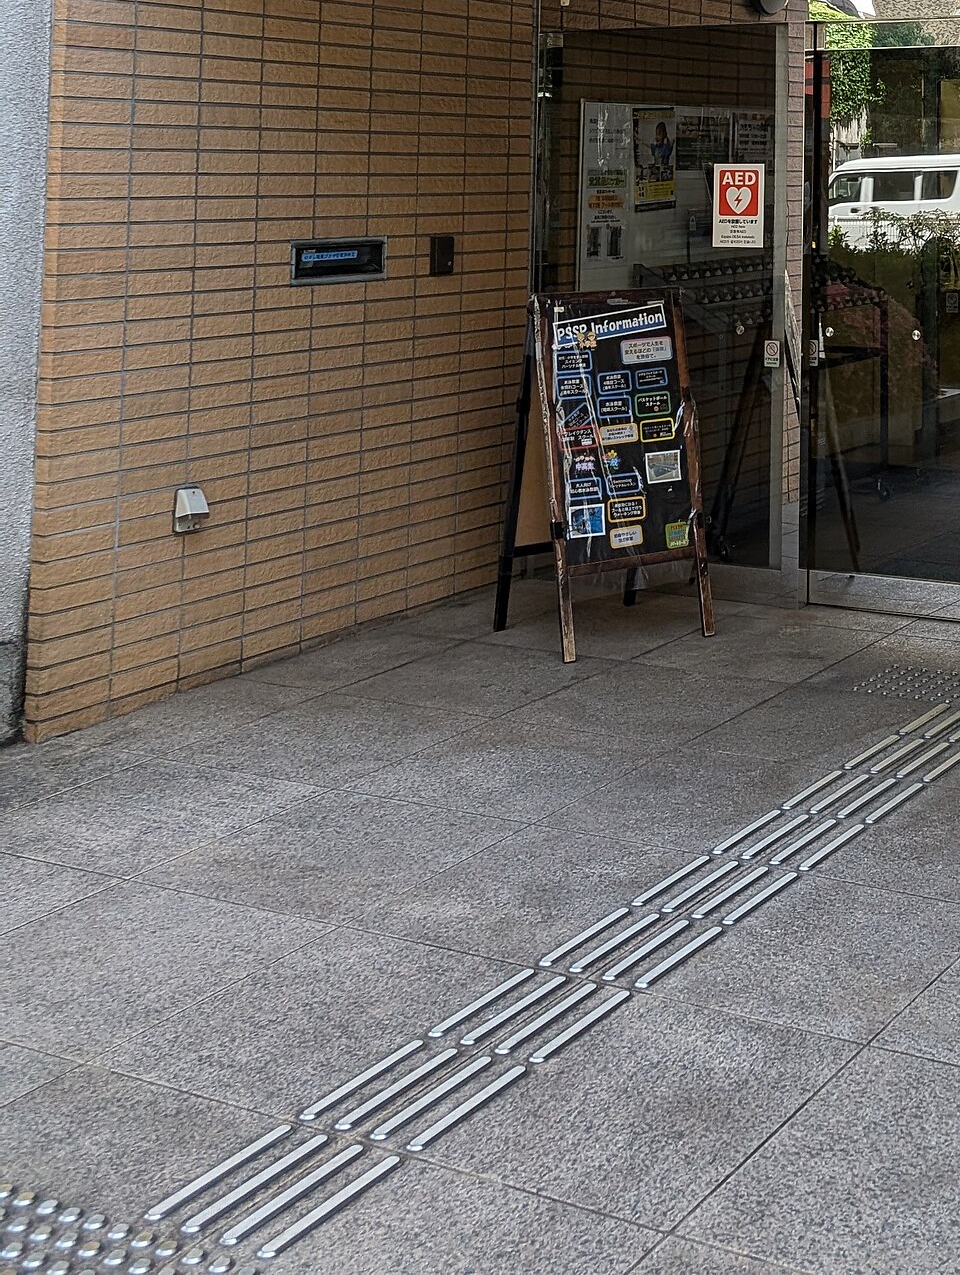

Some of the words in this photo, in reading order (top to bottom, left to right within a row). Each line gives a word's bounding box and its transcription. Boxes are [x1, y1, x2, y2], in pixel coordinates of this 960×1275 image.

[722, 172, 756, 185] AED
[557, 324, 587, 341] PSSP
[591, 312, 663, 334] Information
